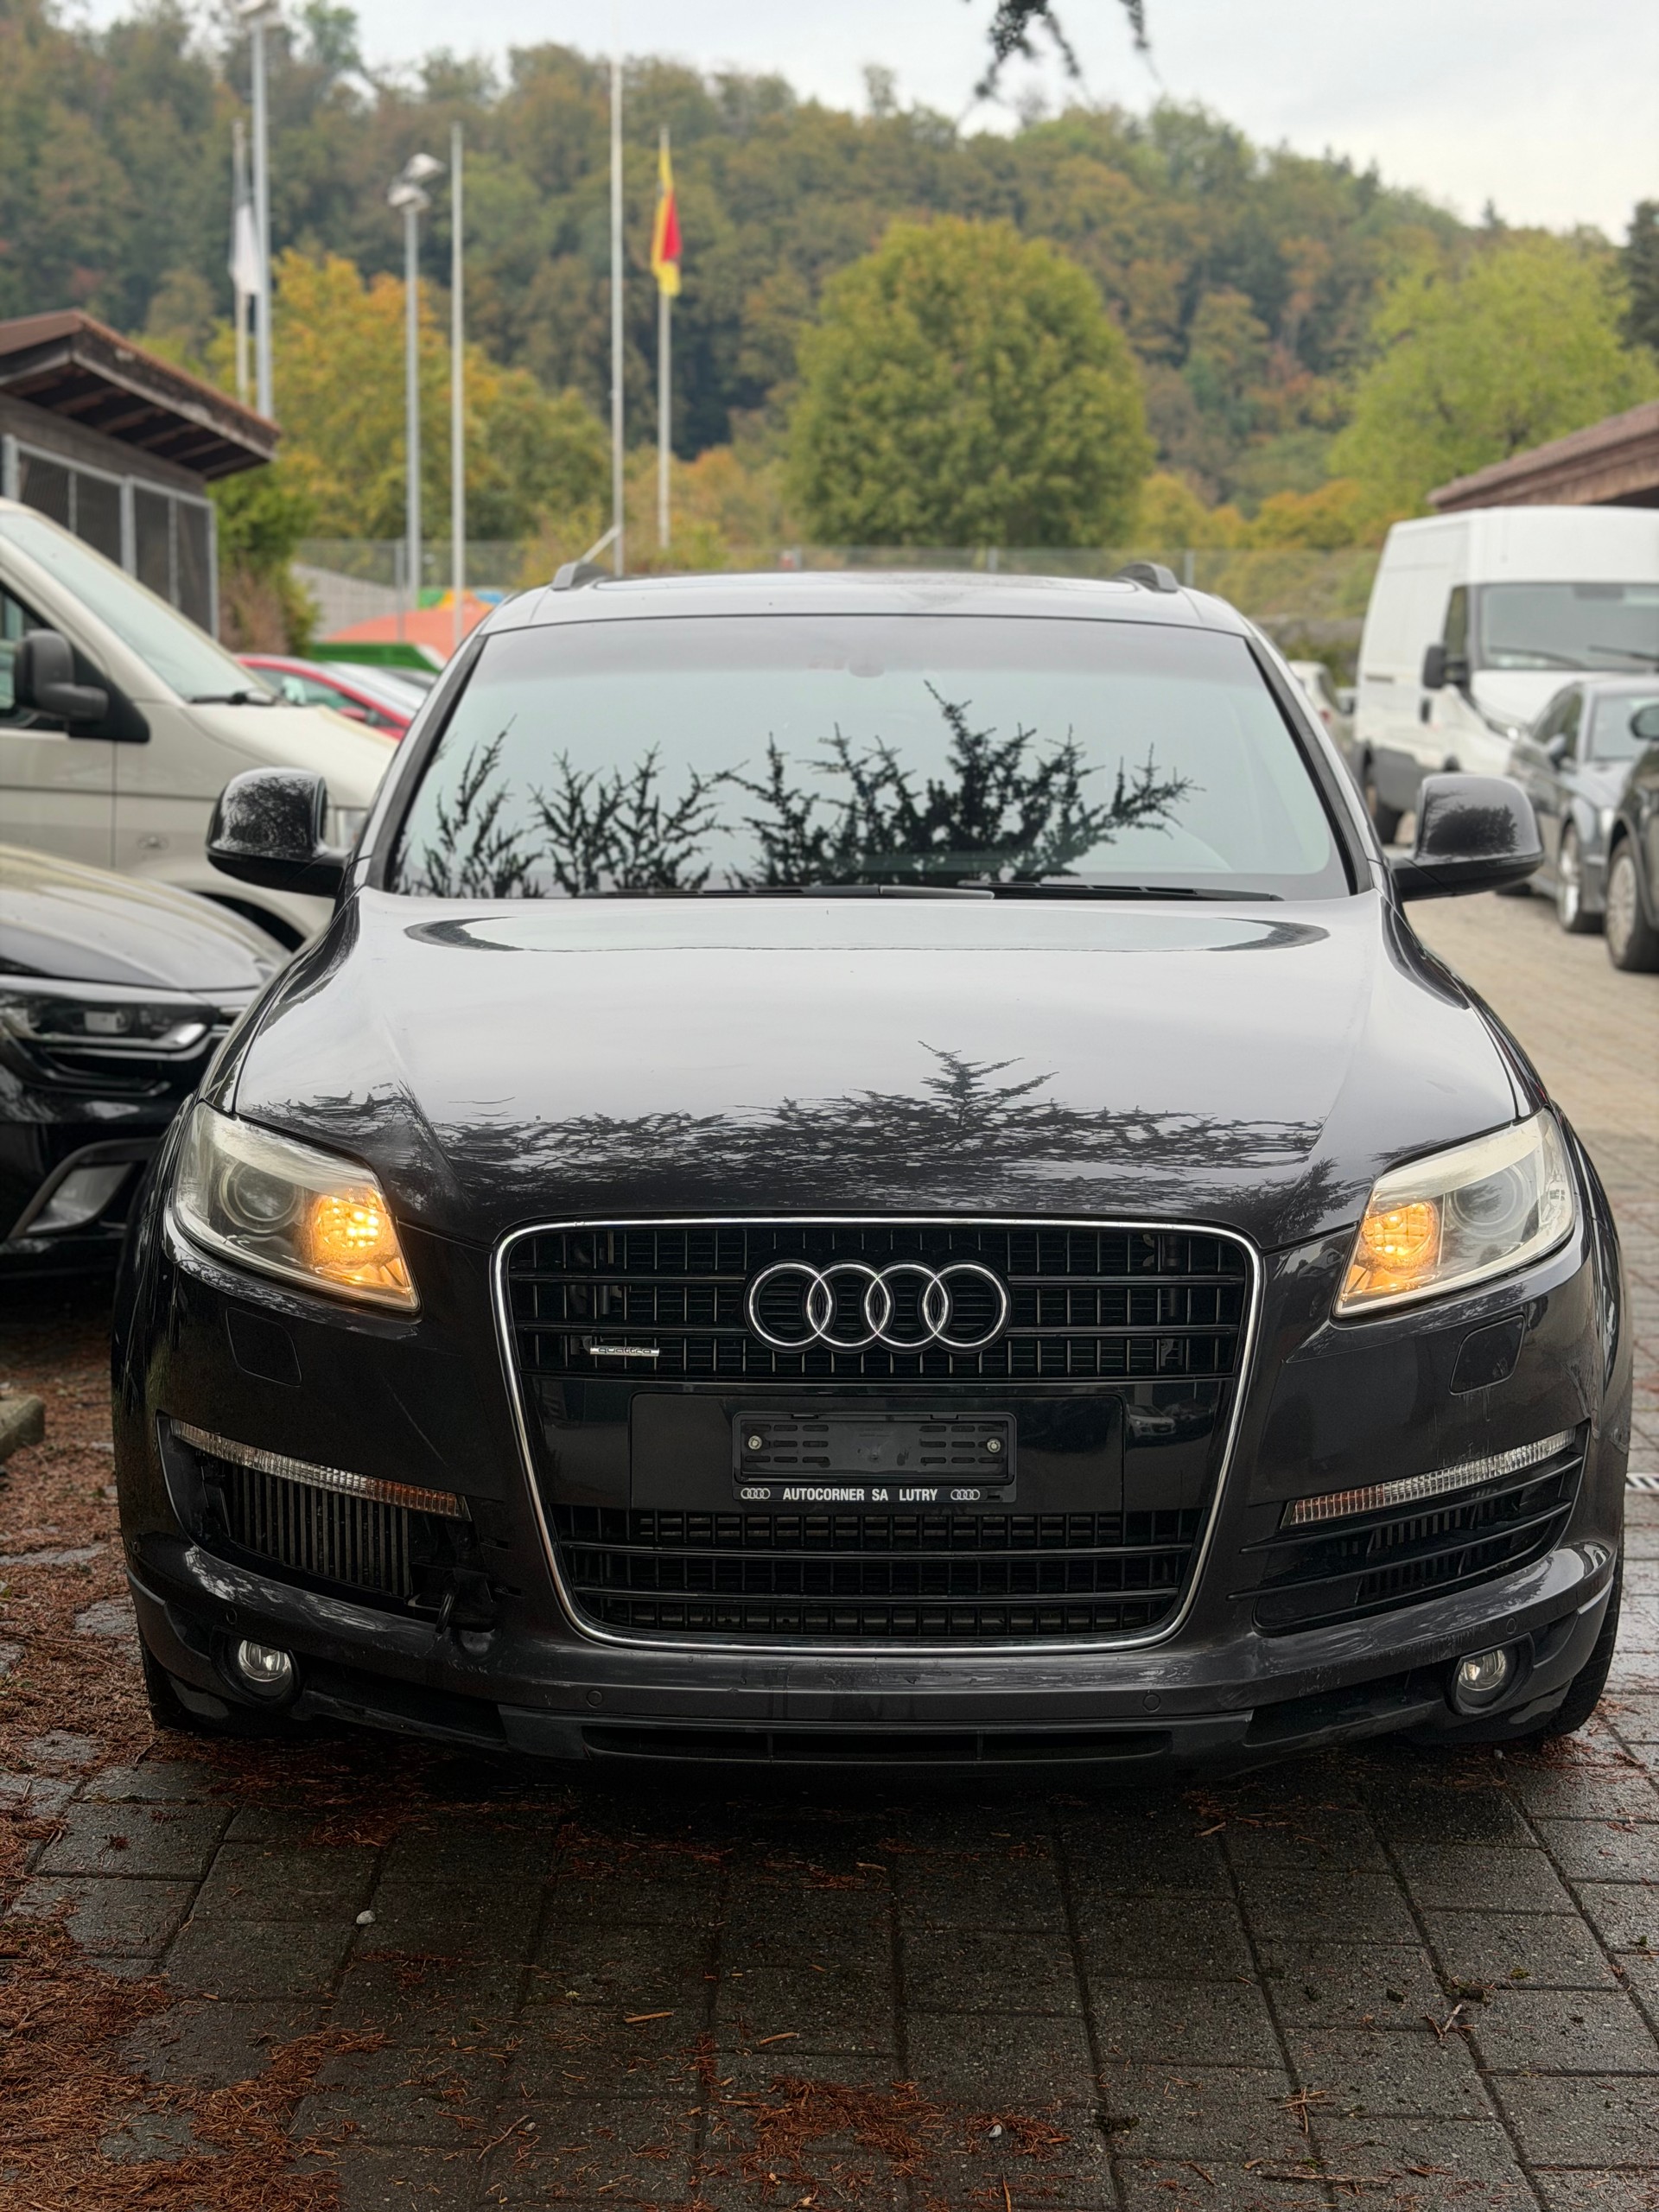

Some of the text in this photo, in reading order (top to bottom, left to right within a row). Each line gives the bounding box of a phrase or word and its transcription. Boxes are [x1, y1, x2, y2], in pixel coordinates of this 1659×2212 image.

[596, 1346, 652, 1355] quattro
[782, 1487, 938, 1502] AUTOCORNER SA LUTRY
